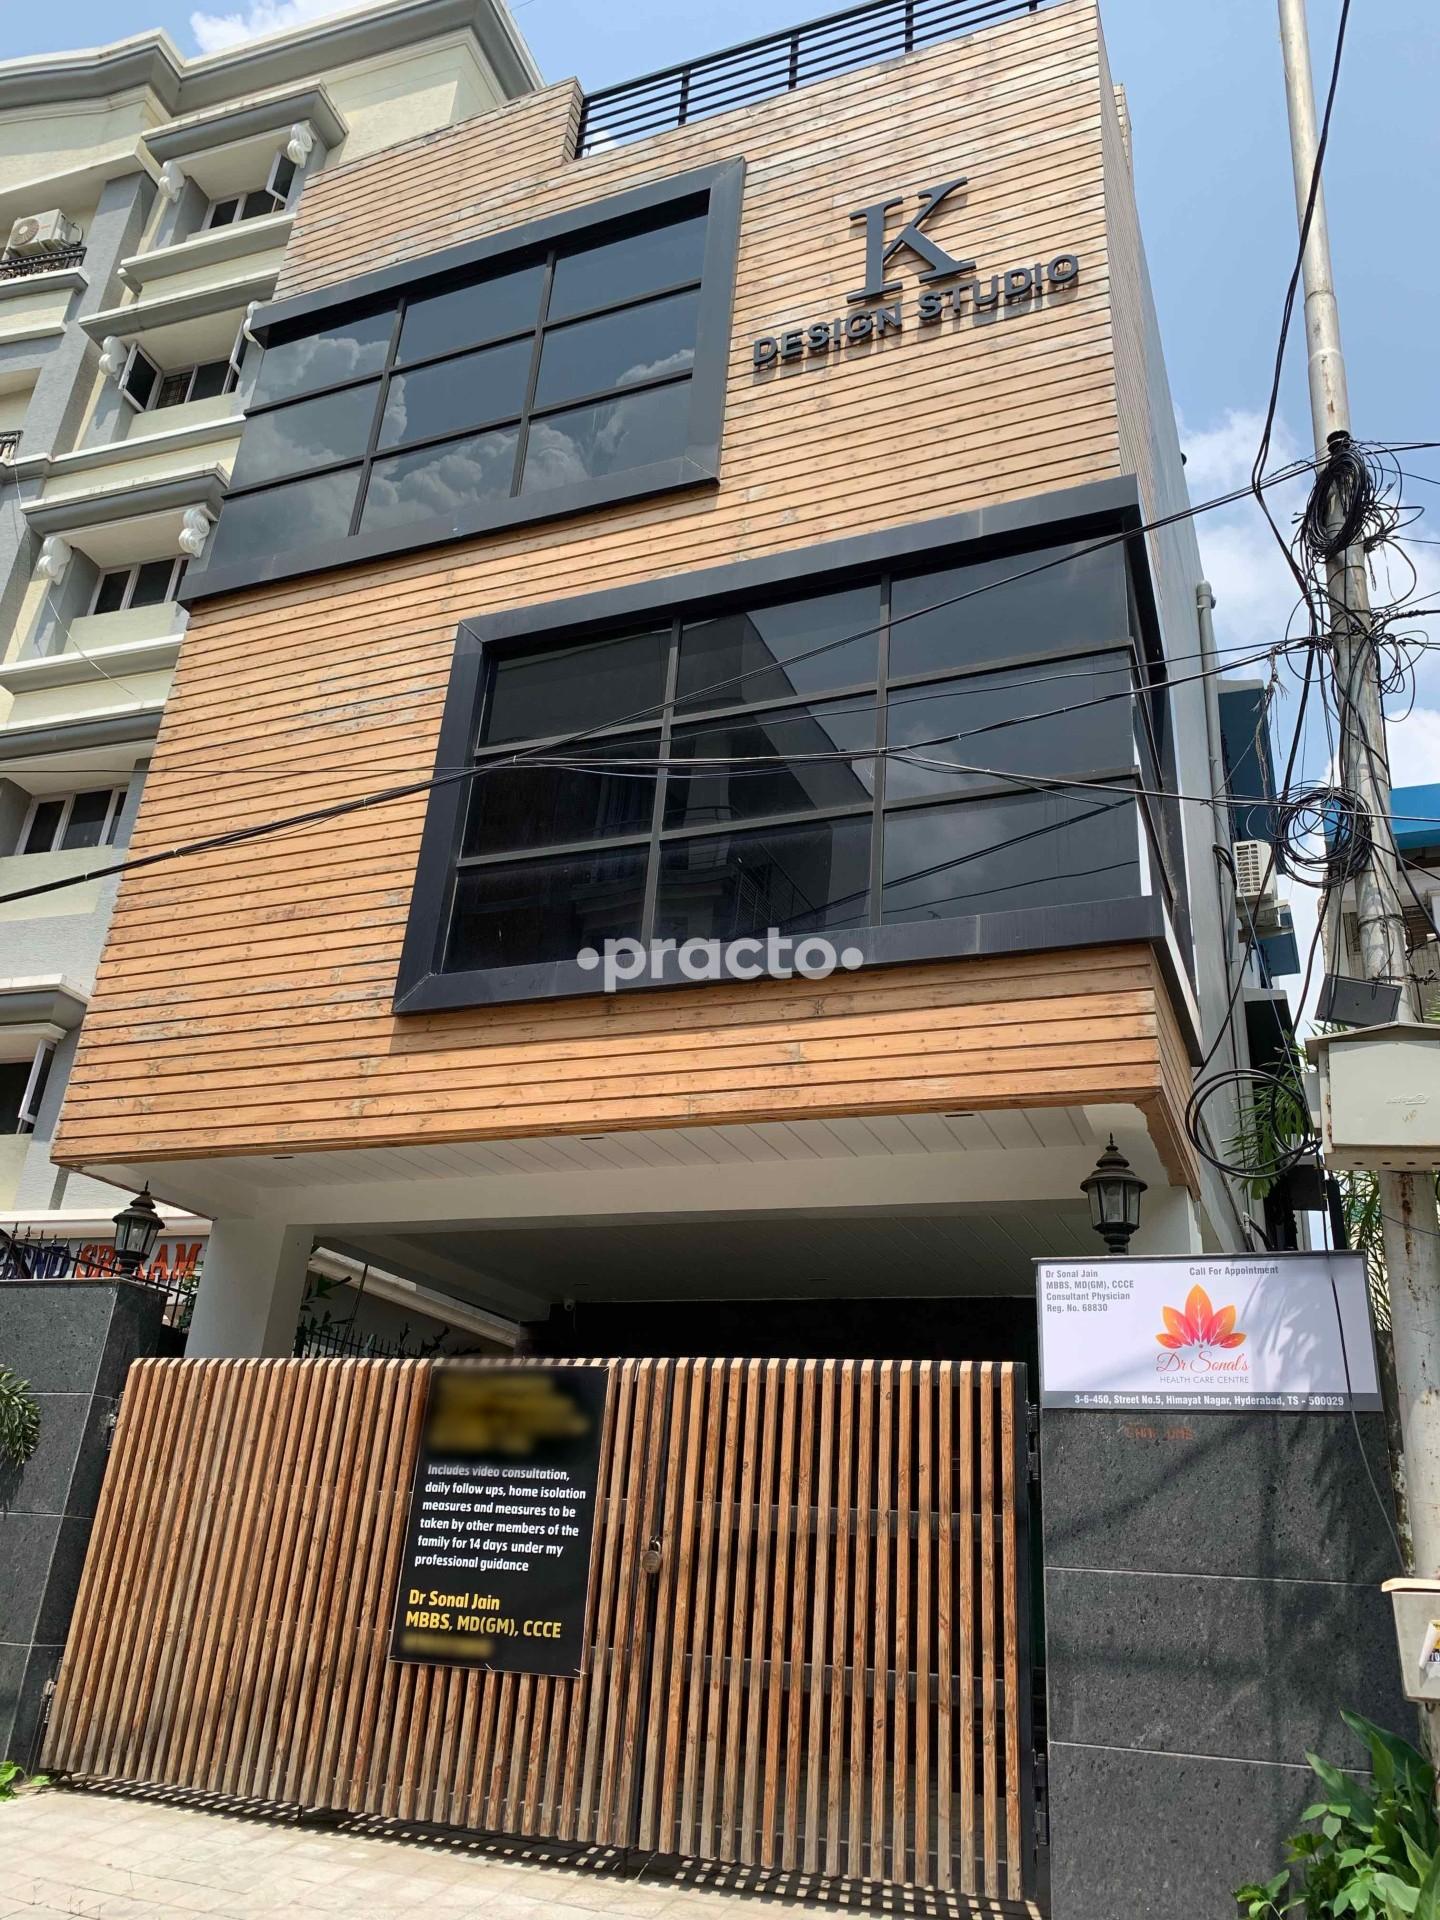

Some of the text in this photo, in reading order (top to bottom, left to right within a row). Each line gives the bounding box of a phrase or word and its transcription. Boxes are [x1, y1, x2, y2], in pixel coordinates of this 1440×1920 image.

[847, 177, 976, 304] K
[753, 254, 1078, 366] DESIGN STUDIO
[1057, 1270, 1078, 1278] Sonal
[1190, 1266, 1279, 1276] Call For Appointment
[1047, 1280, 1134, 1289] MBBS, MD(GM), CCCE
[1047, 1292, 1130, 1301] Consultant Physician
[1047, 1304, 1064, 1313] Reg.
[1156, 1351, 1248, 1373] Dr Sonal's
[1074, 1395, 1111, 1405] 3-6-450,
[1114, 1395, 1139, 1404] Street
[1142, 1395, 1164, 1405] No.5,
[1166, 1396, 1201, 1406] Himayat
[1204, 1396, 1231, 1406] Nagar,
[1234, 1396, 1285, 1406] Hyderabad,
[1287, 1396, 1298, 1405] TS
[1309, 1396, 1344, 1406] 500029
[428, 1464, 570, 1481] Includes video consultation,
[425, 1482, 586, 1500] daily follow ups, home isolation
[423, 1501, 576, 1517] measures and measures to be
[420, 1518, 579, 1536] taken by other members of the
[417, 1536, 563, 1557] family for 14 days under my
[414, 1554, 529, 1571] professional guidance
[409, 1589, 500, 1610] Dr Sonal Jain
[406, 1611, 562, 1638] MBBS, MD(GM), CCCE
